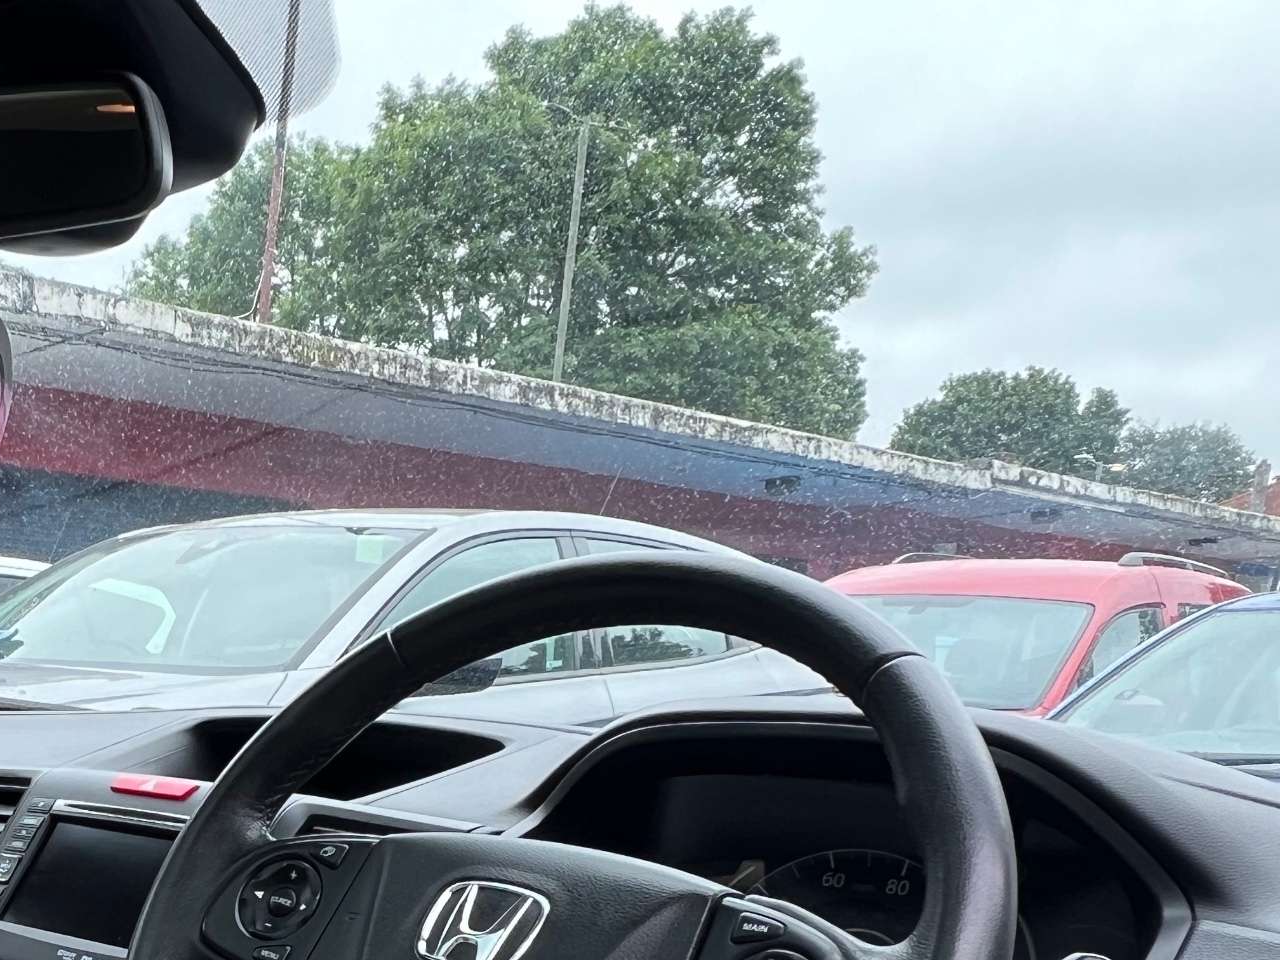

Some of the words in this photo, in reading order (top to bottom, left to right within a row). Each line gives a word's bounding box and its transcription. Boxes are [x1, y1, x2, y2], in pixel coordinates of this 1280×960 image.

[822, 872, 845, 888] 60
[885, 878, 909, 896] 80
[741, 922, 769, 933] MAIN
[260, 949, 280, 960] MENU
